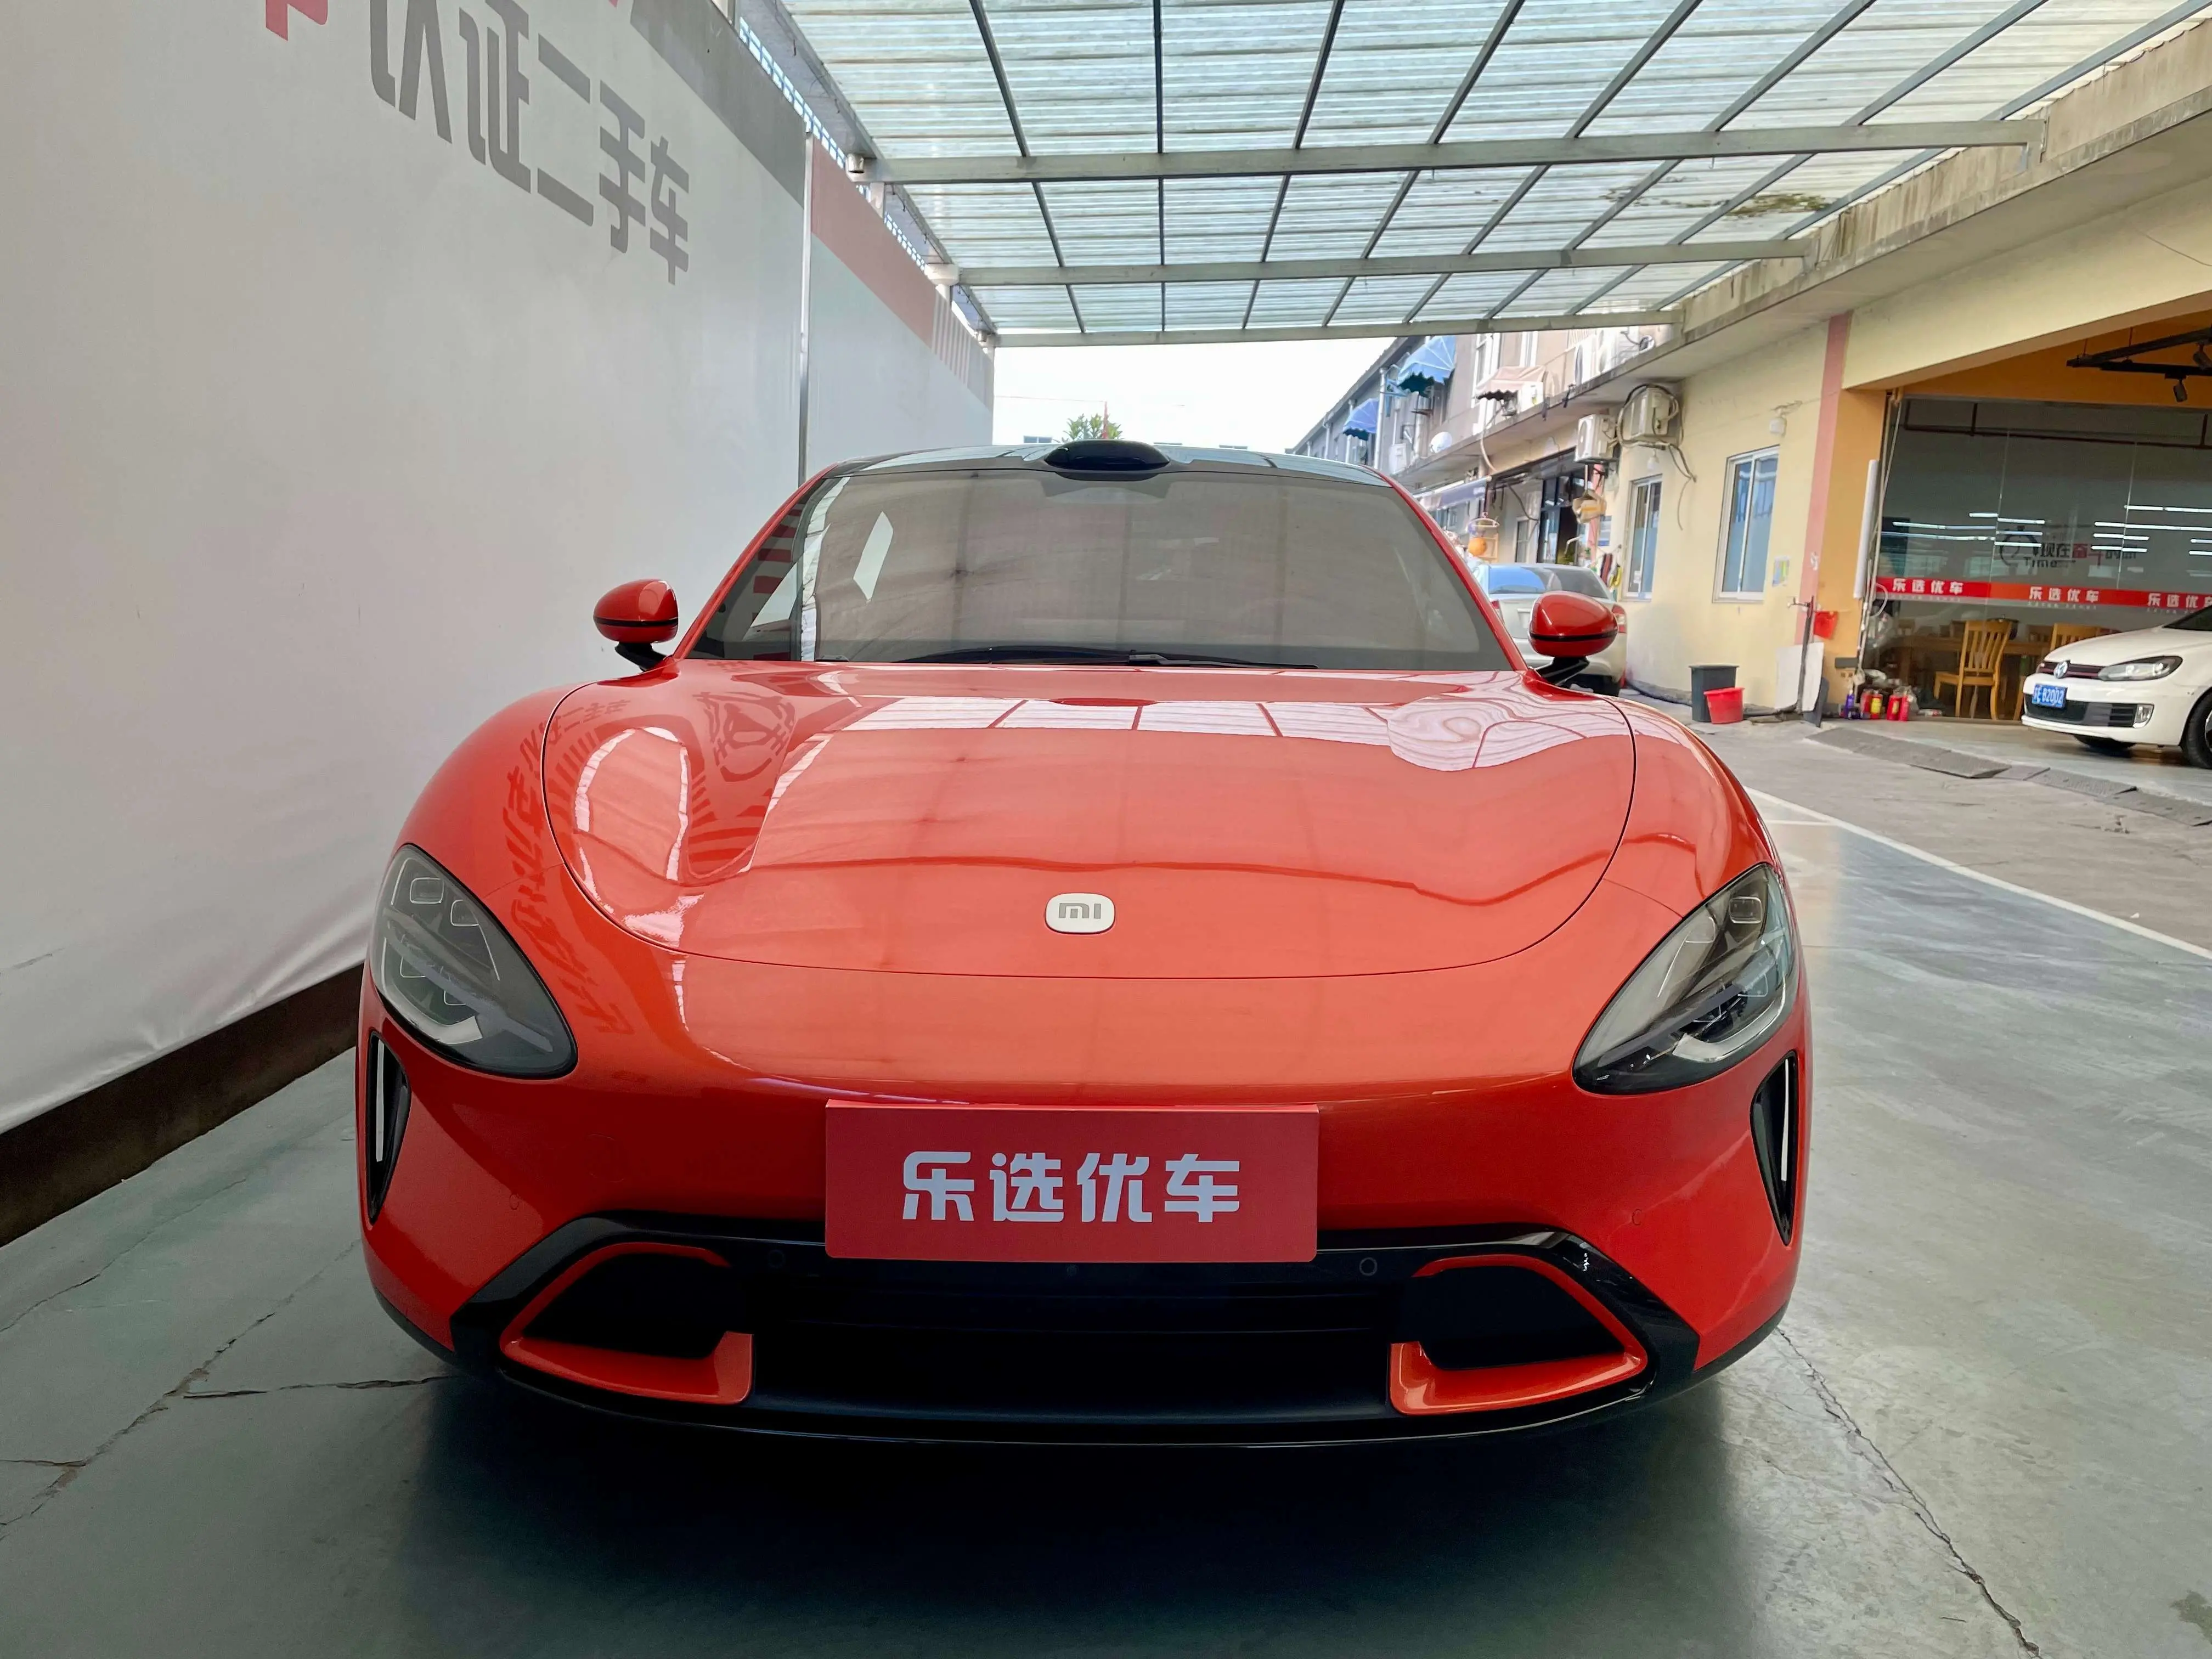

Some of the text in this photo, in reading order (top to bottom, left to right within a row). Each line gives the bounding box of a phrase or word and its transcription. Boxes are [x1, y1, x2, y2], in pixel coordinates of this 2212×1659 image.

[1893, 578, 1964, 595] 乐选优车
[2029, 586, 2100, 603] 乐选优车
[902, 1151, 1240, 1223] 乐选优车
